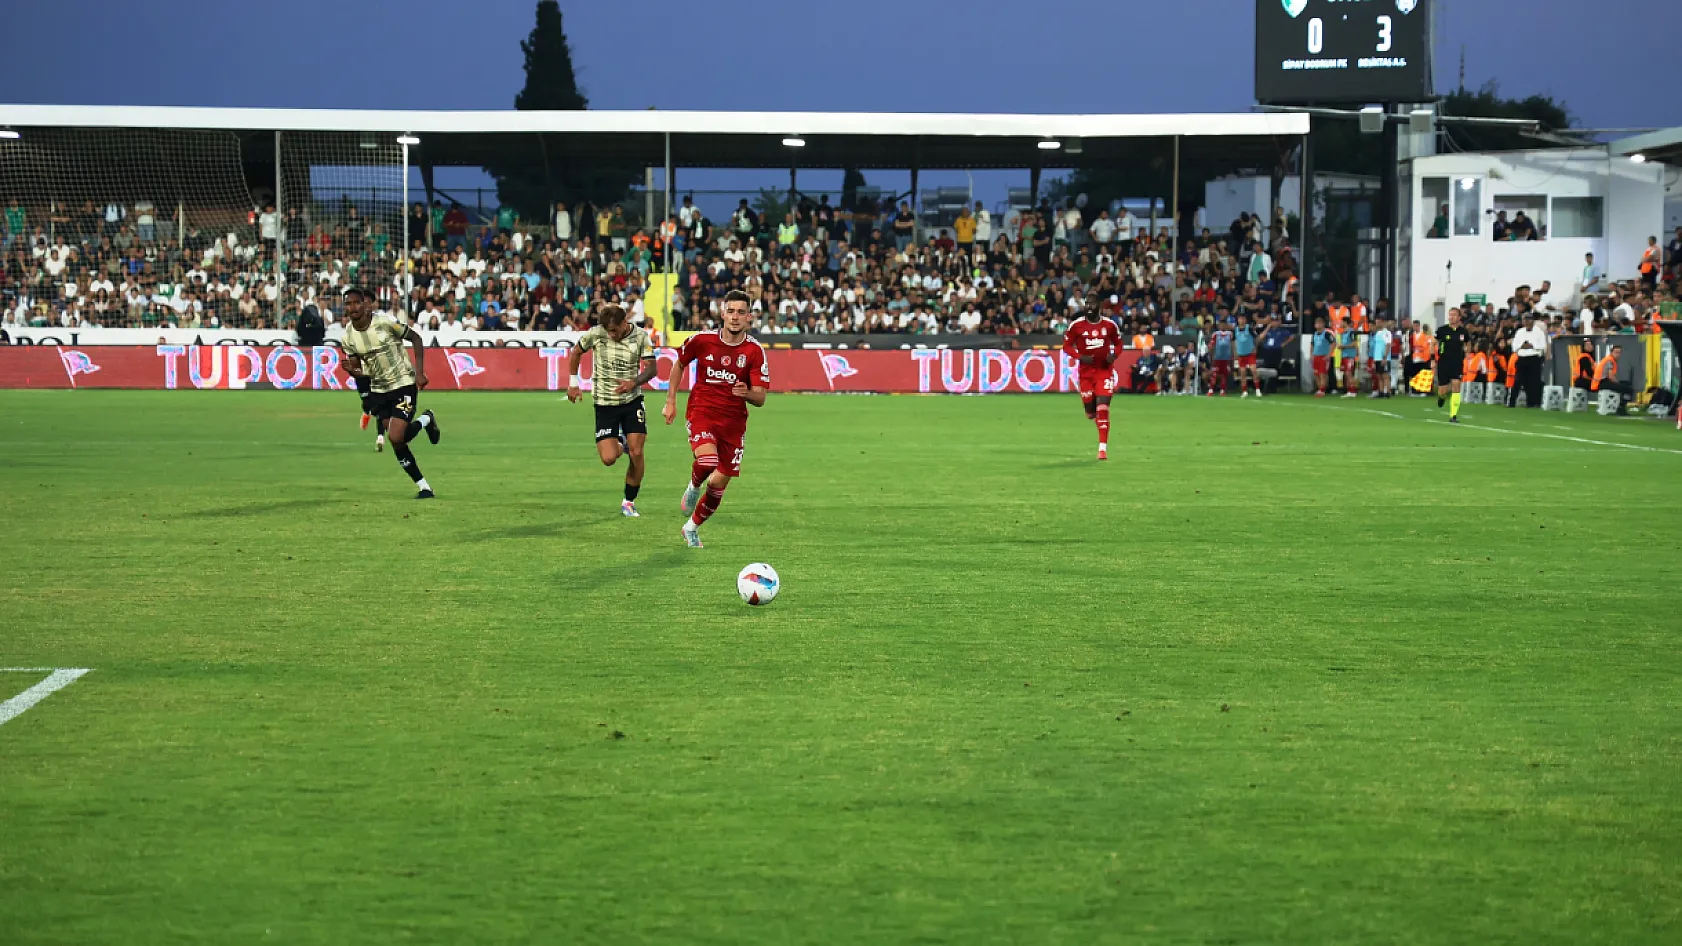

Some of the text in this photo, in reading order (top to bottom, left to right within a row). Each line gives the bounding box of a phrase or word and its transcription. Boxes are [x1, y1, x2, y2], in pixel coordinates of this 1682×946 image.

[1307, 17, 1323, 54] 0
[1376, 15, 1392, 52] 3
[157, 345, 358, 390] TUDOR
[706, 366, 737, 383] beko
[911, 349, 1118, 392] TUDOR
[636, 409, 645, 423] 9
